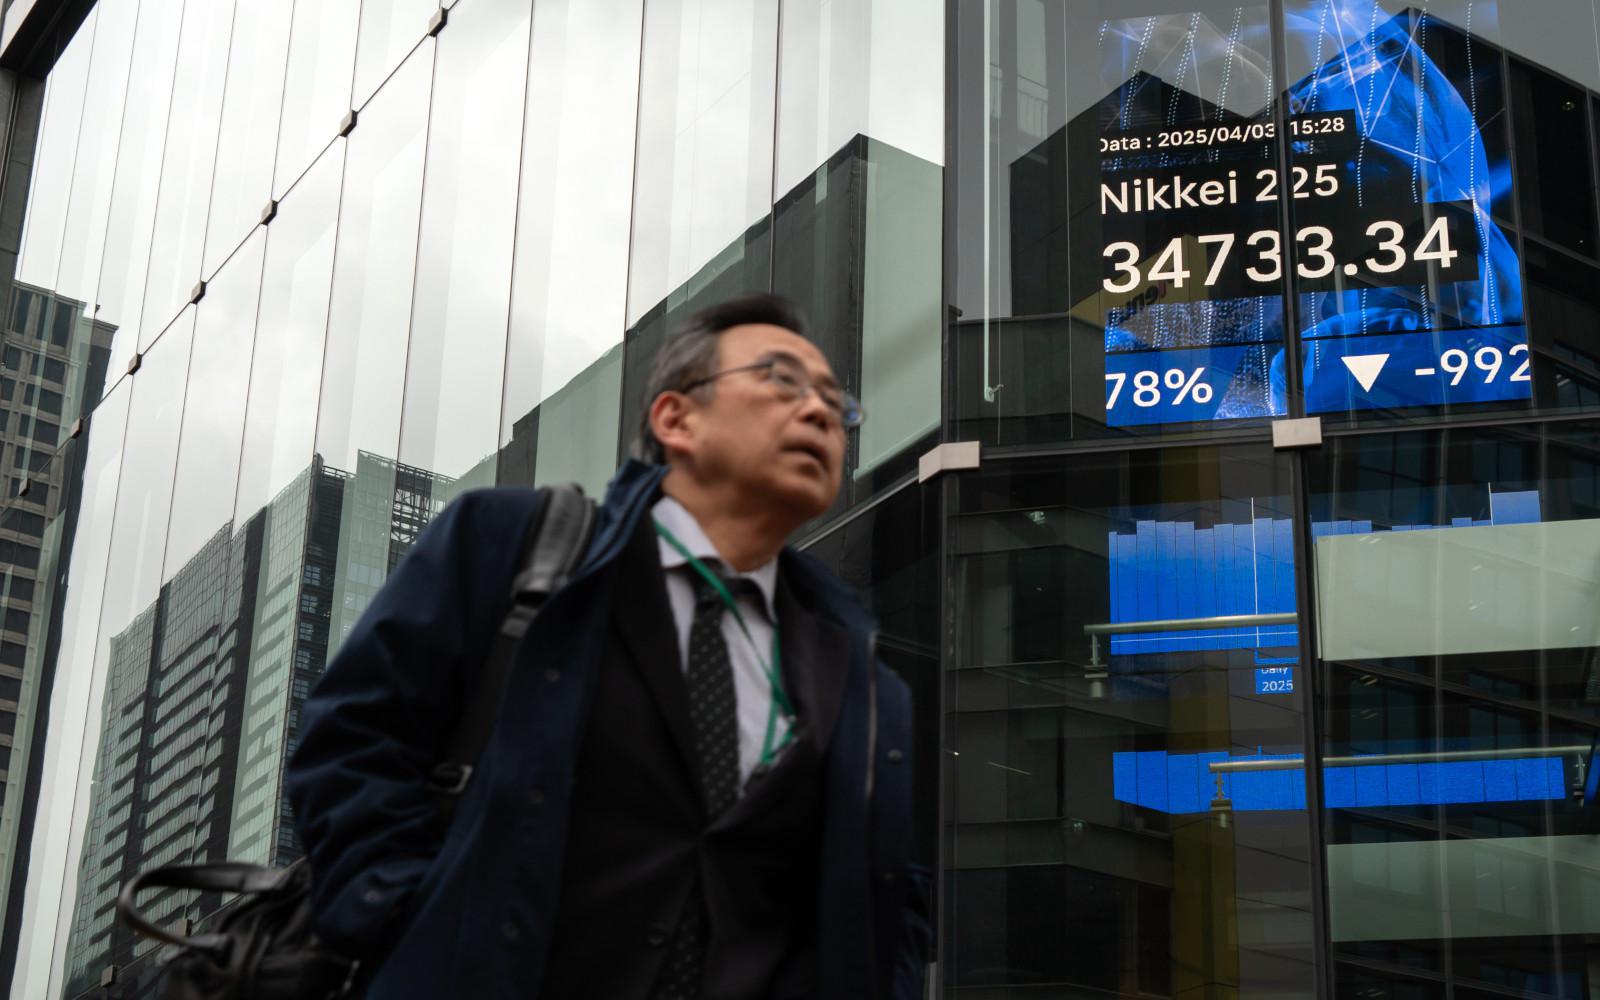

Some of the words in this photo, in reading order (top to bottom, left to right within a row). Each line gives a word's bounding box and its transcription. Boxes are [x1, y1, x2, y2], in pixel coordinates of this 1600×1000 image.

[1158, 123, 1275, 147] 2025/04/03
[1290, 117, 1345, 135] 15:28
[1100, 171, 1237, 214] Nikkei
[1255, 164, 1339, 202] 225
[1103, 216, 1458, 294] 34733.34
[1414, 343, 1531, 386] -992
[1105, 367, 1213, 410] 78%
[1262, 680, 1293, 692] 2025
